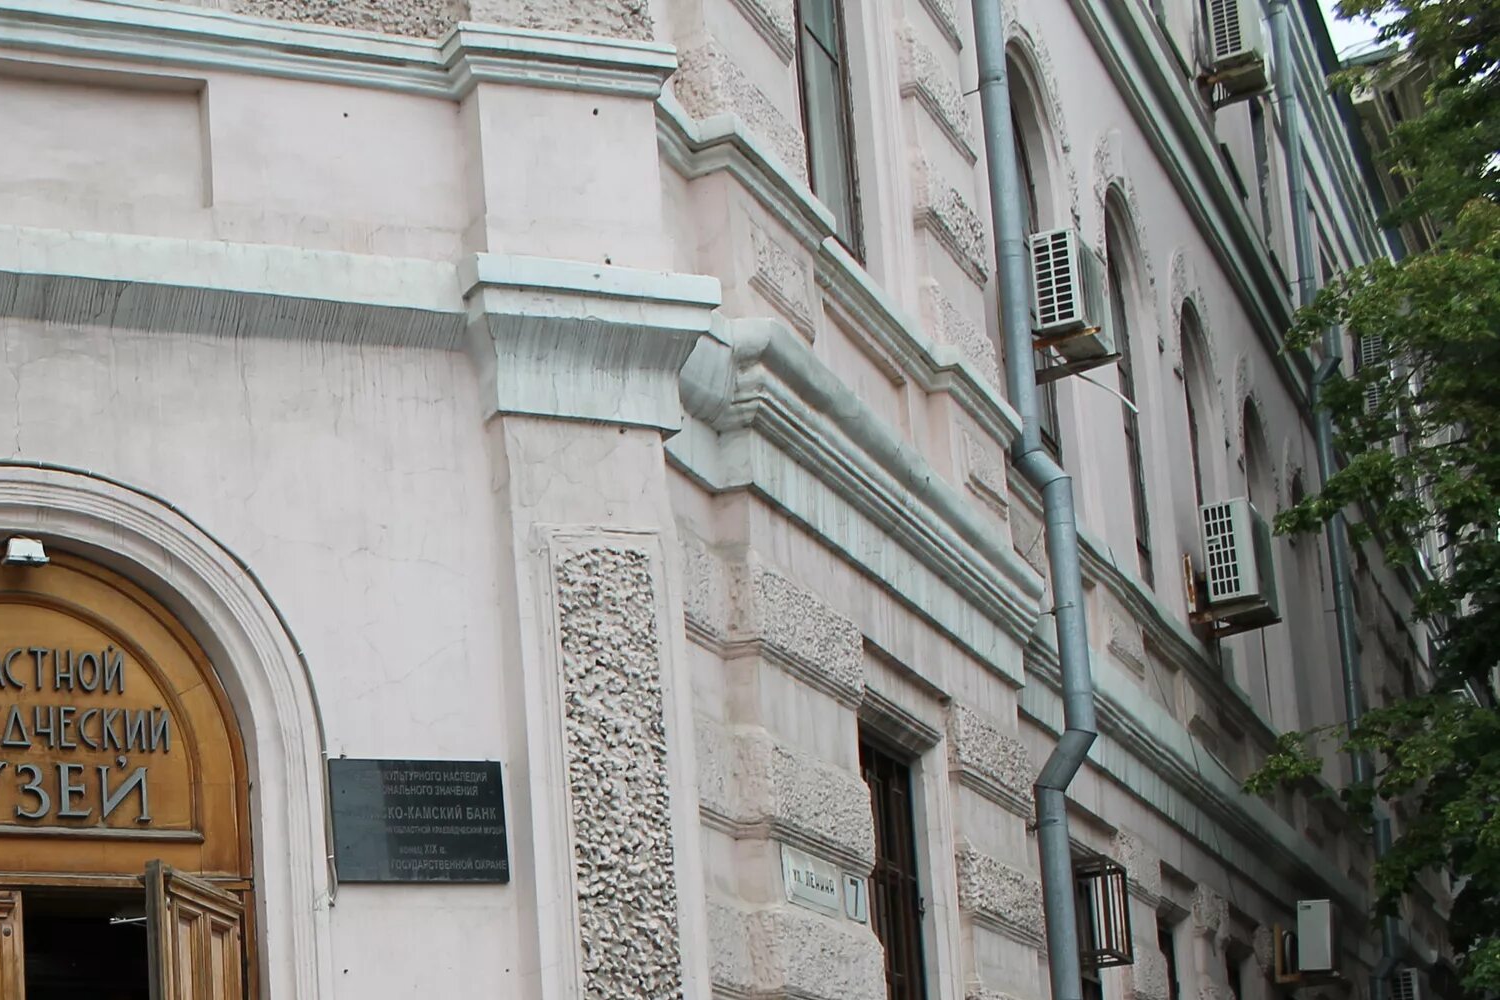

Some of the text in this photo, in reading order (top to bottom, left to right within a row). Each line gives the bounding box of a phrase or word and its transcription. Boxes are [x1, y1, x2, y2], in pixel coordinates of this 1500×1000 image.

[384, 784, 433, 795] ОНАЛЬНОГО
[384, 805, 496, 820] КО-КАМСКИЙ БАНК
[424, 844, 437, 854] XIX
[849, 878, 859, 917] 7
